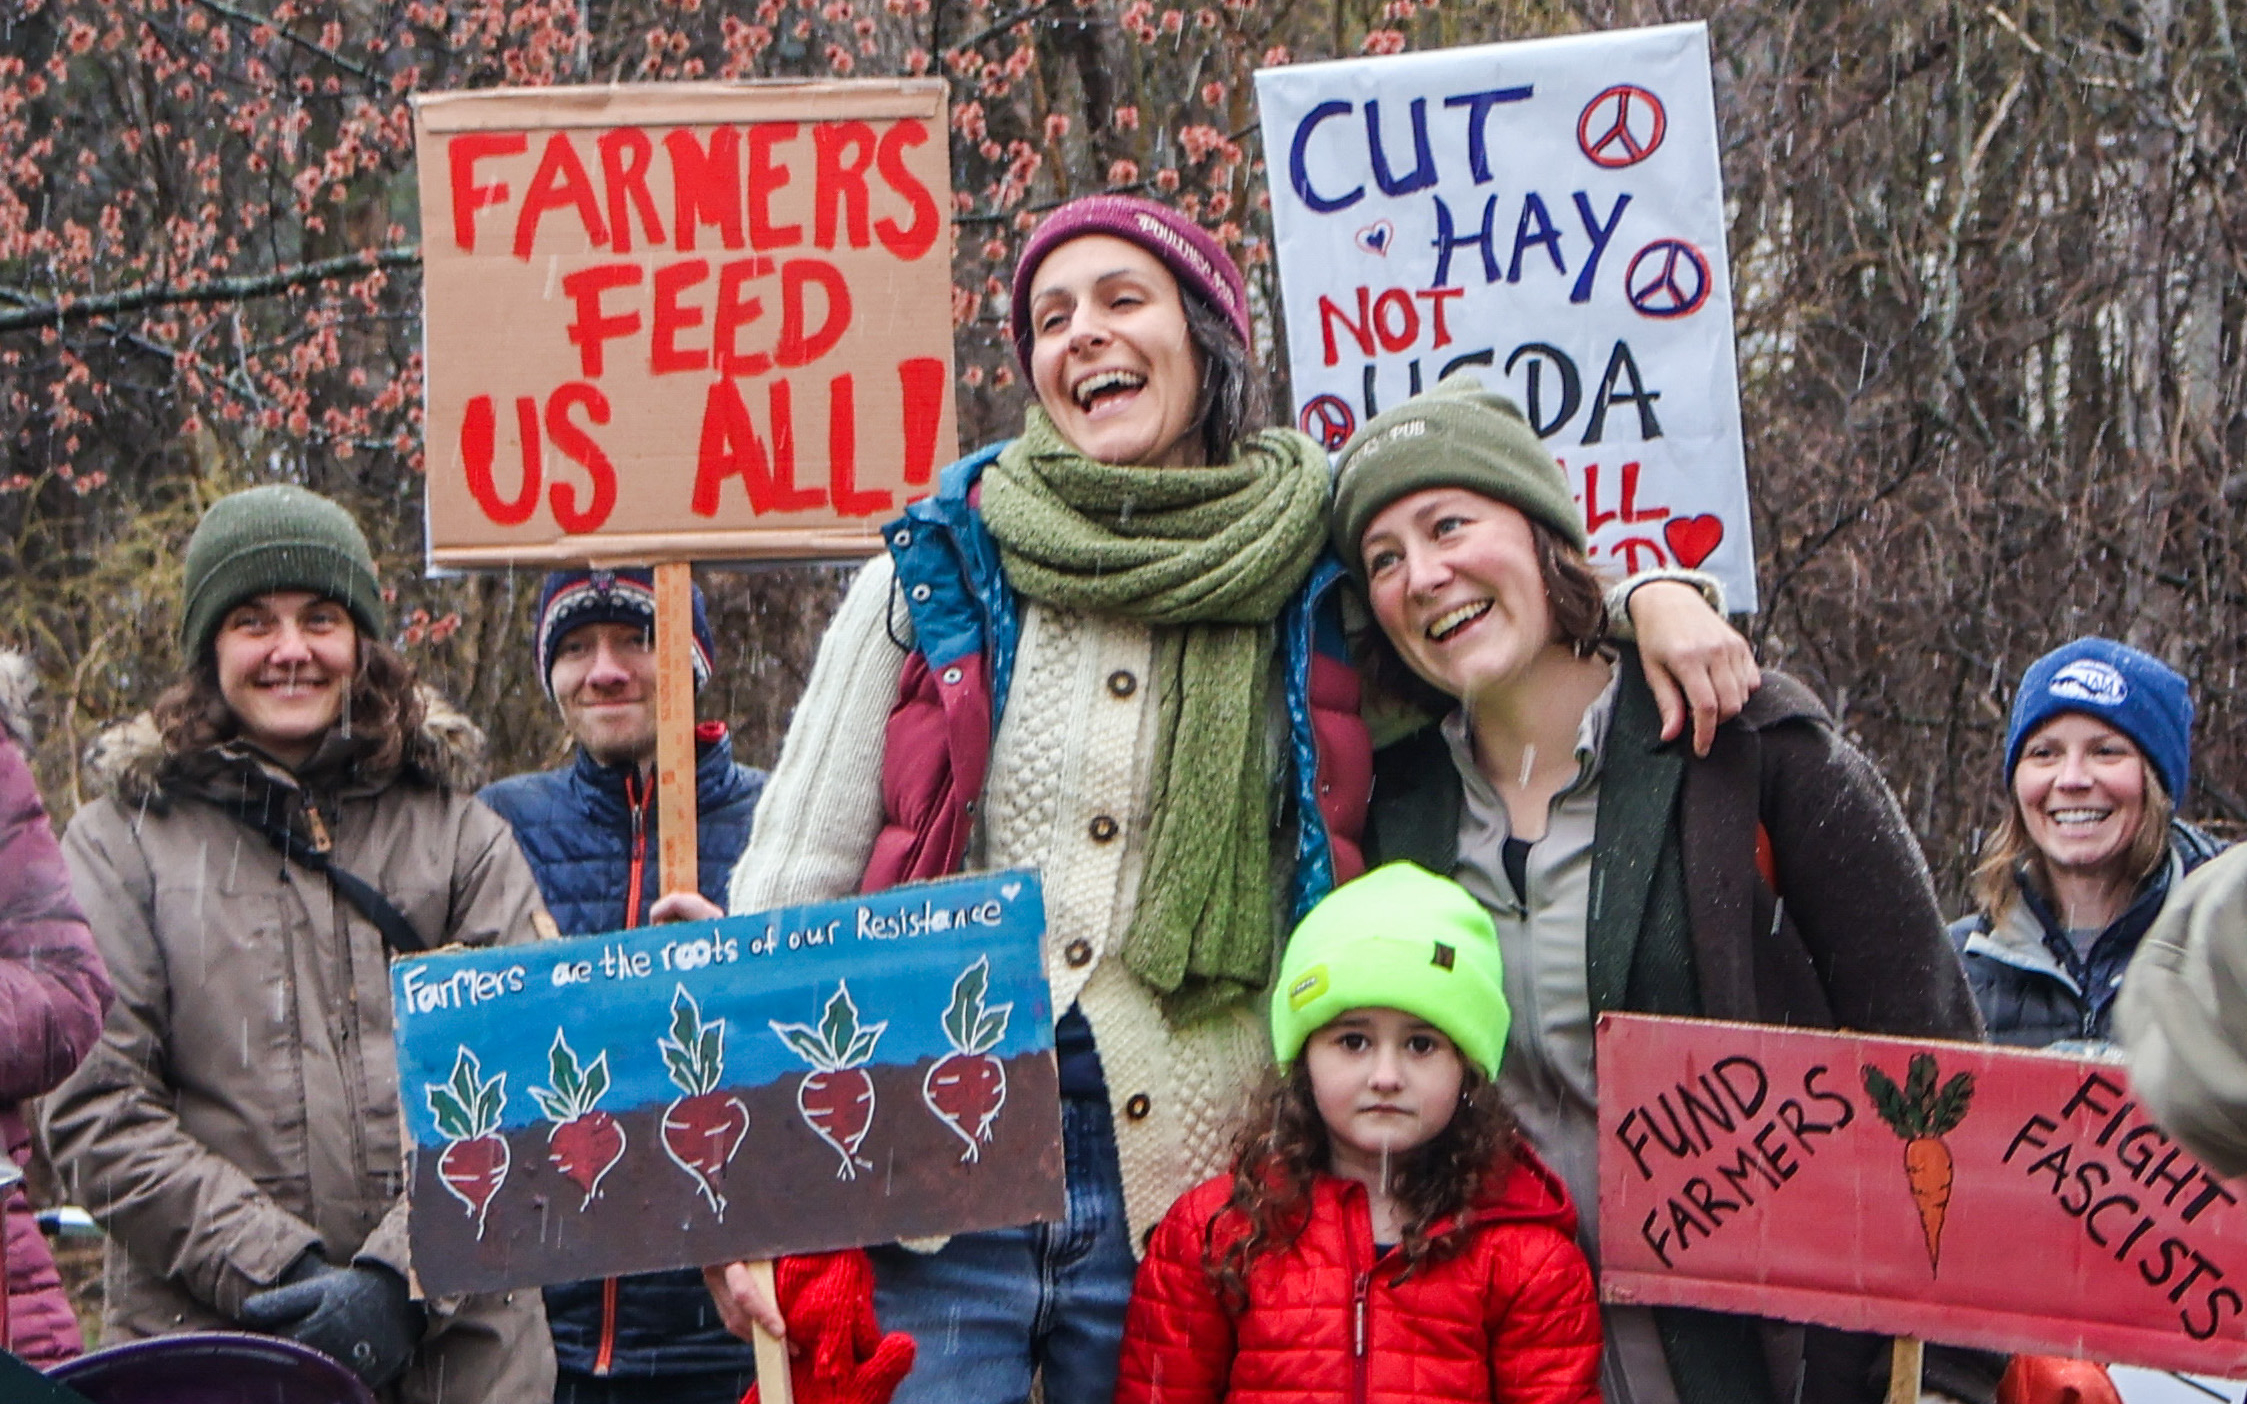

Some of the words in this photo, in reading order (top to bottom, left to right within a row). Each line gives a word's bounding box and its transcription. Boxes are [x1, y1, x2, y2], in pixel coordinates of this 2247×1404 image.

[448, 117, 940, 262] FARMERS
[1289, 84, 1535, 214] CUT
[1430, 191, 1633, 304] HAY
[563, 257, 852, 378] FEED
[1317, 286, 1465, 367] NOT
[461, 382, 618, 534] US
[1389, 419, 1426, 438] PUB
[1556, 457, 1671, 536] LL
[551, 959, 593, 987] are
[599, 943, 651, 981] the
[660, 927, 740, 972] roots
[751, 924, 776, 956] of
[788, 919, 841, 950] our
[856, 899, 1002, 941] Resistance
[1614, 1054, 1769, 1182] FUND
[1641, 1063, 1856, 1270] FARMERS
[2061, 1072, 2238, 1226] FIGHT
[2001, 1113, 2245, 1342] FASCISTS
